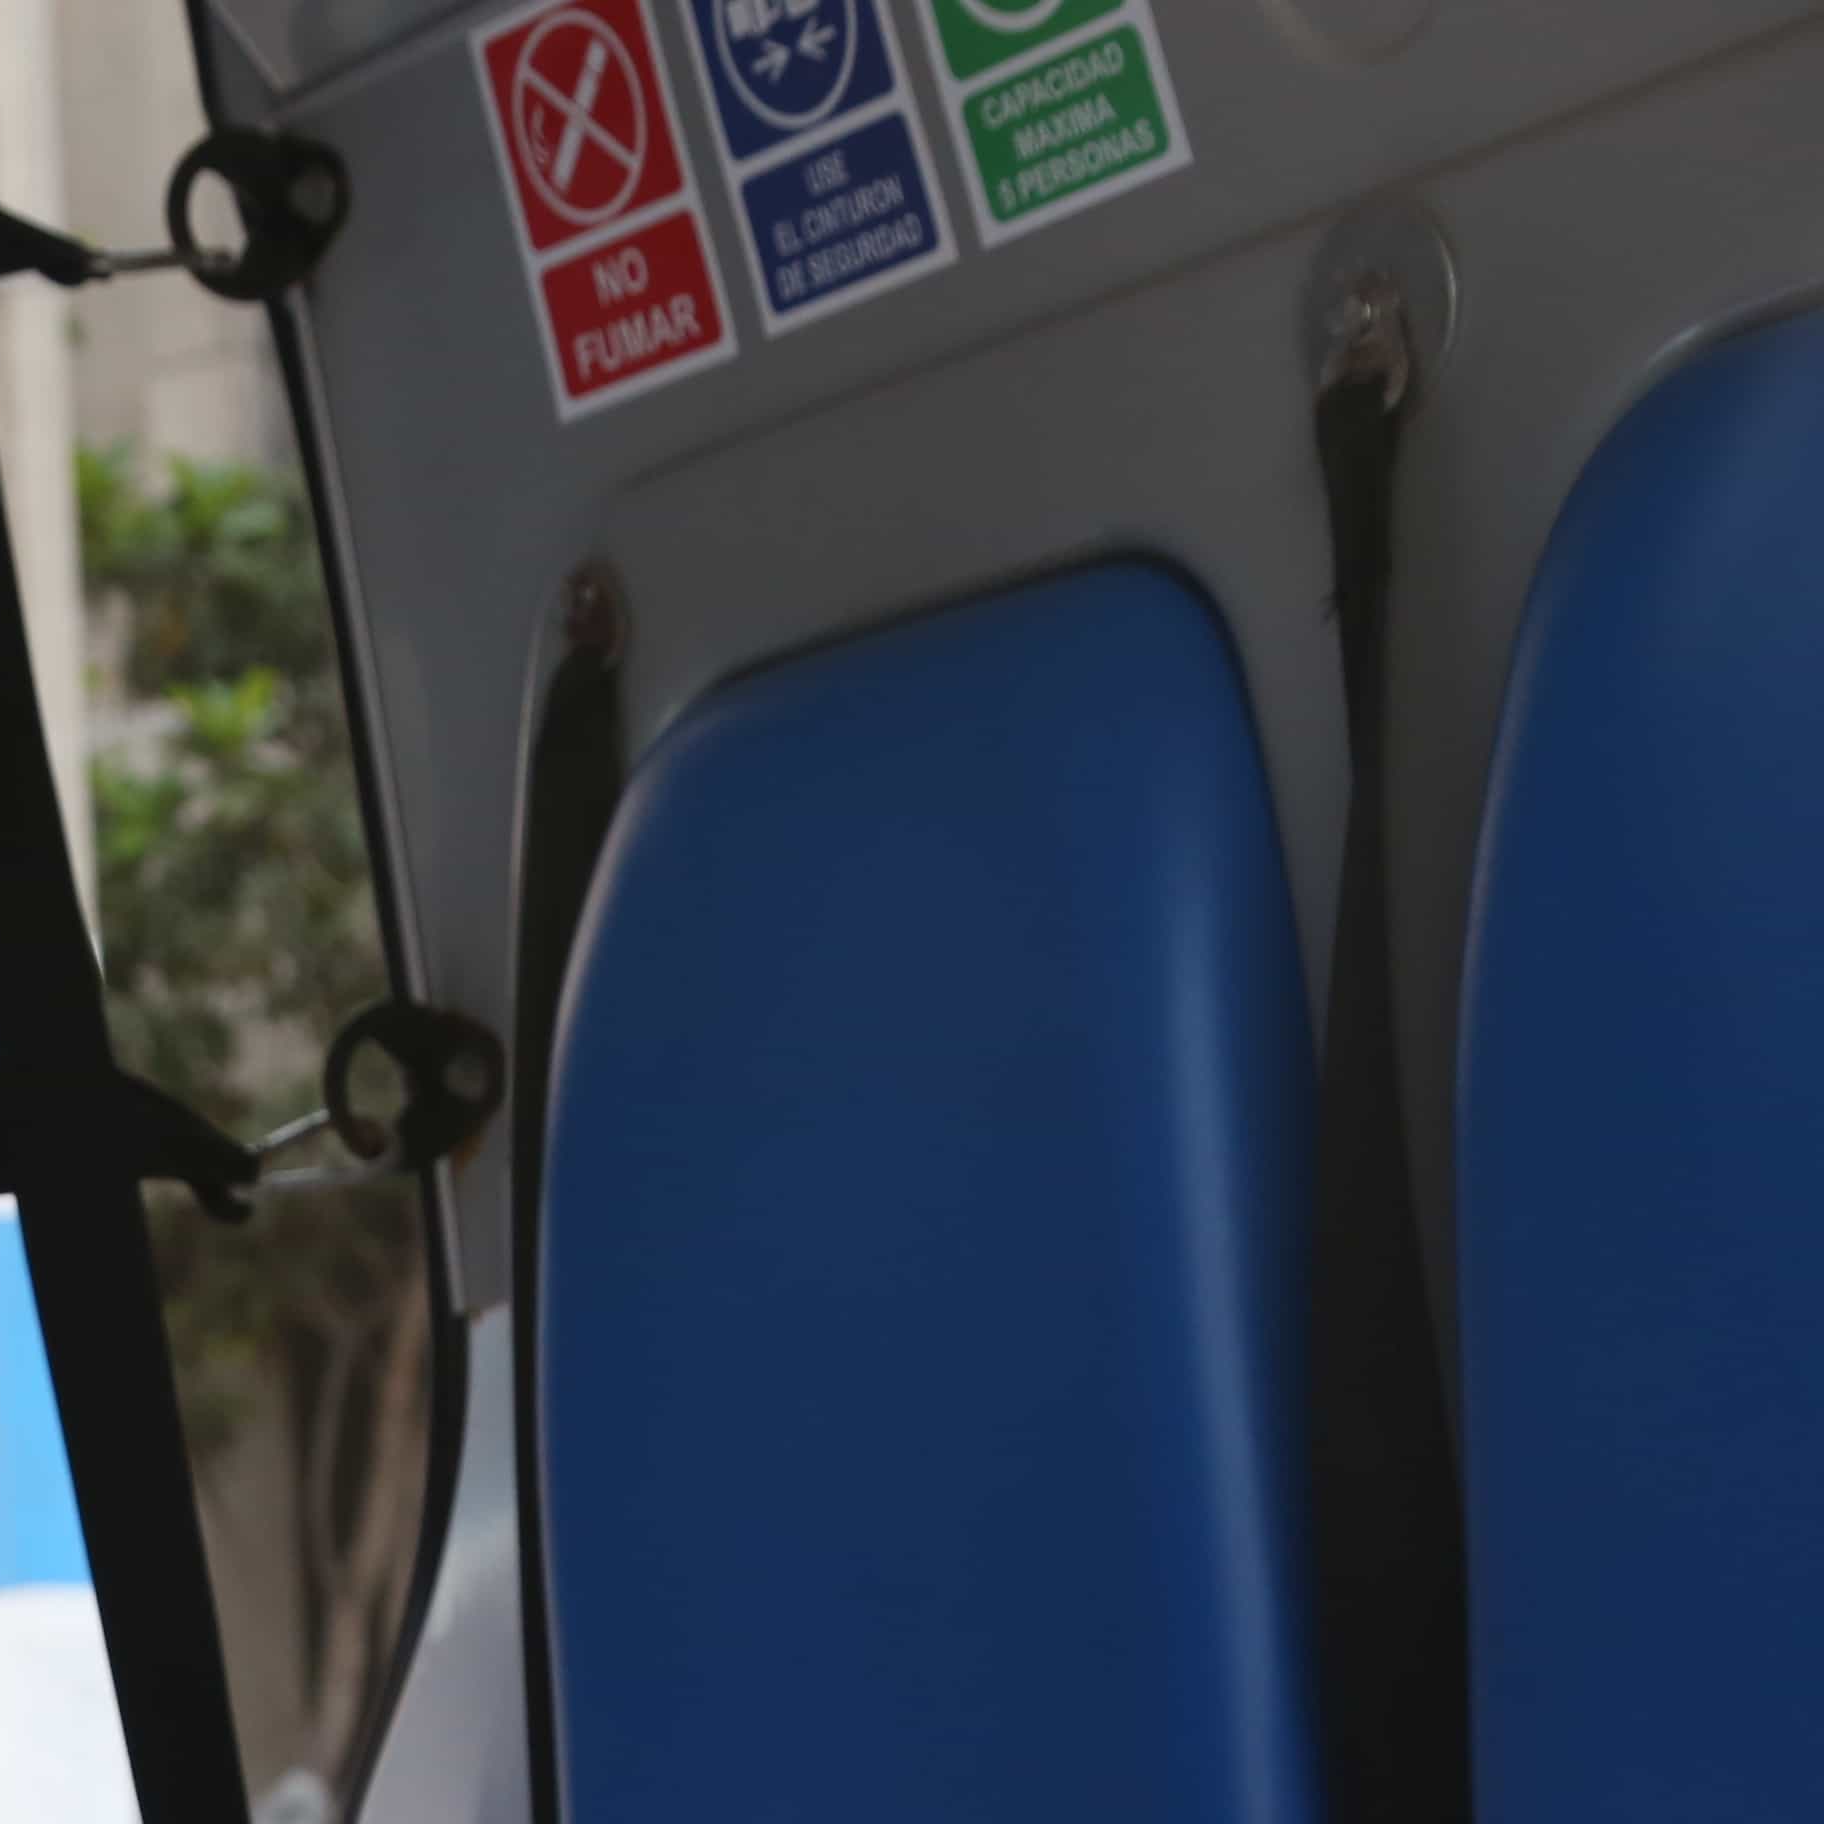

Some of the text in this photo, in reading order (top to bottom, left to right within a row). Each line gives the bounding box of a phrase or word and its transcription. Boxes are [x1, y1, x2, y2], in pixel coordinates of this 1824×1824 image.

[982, 41, 1124, 130] CAPACIDAD
[1013, 92, 1117, 161] MAXIMA
[805, 149, 848, 195] USE
[1015, 117, 1155, 201] PERSONAS
[773, 174, 904, 258] EL CINTURON
[776, 212, 923, 298] DE SEGURIDAD
[592, 247, 649, 308] NO
[573, 292, 701, 383] FUMAR
